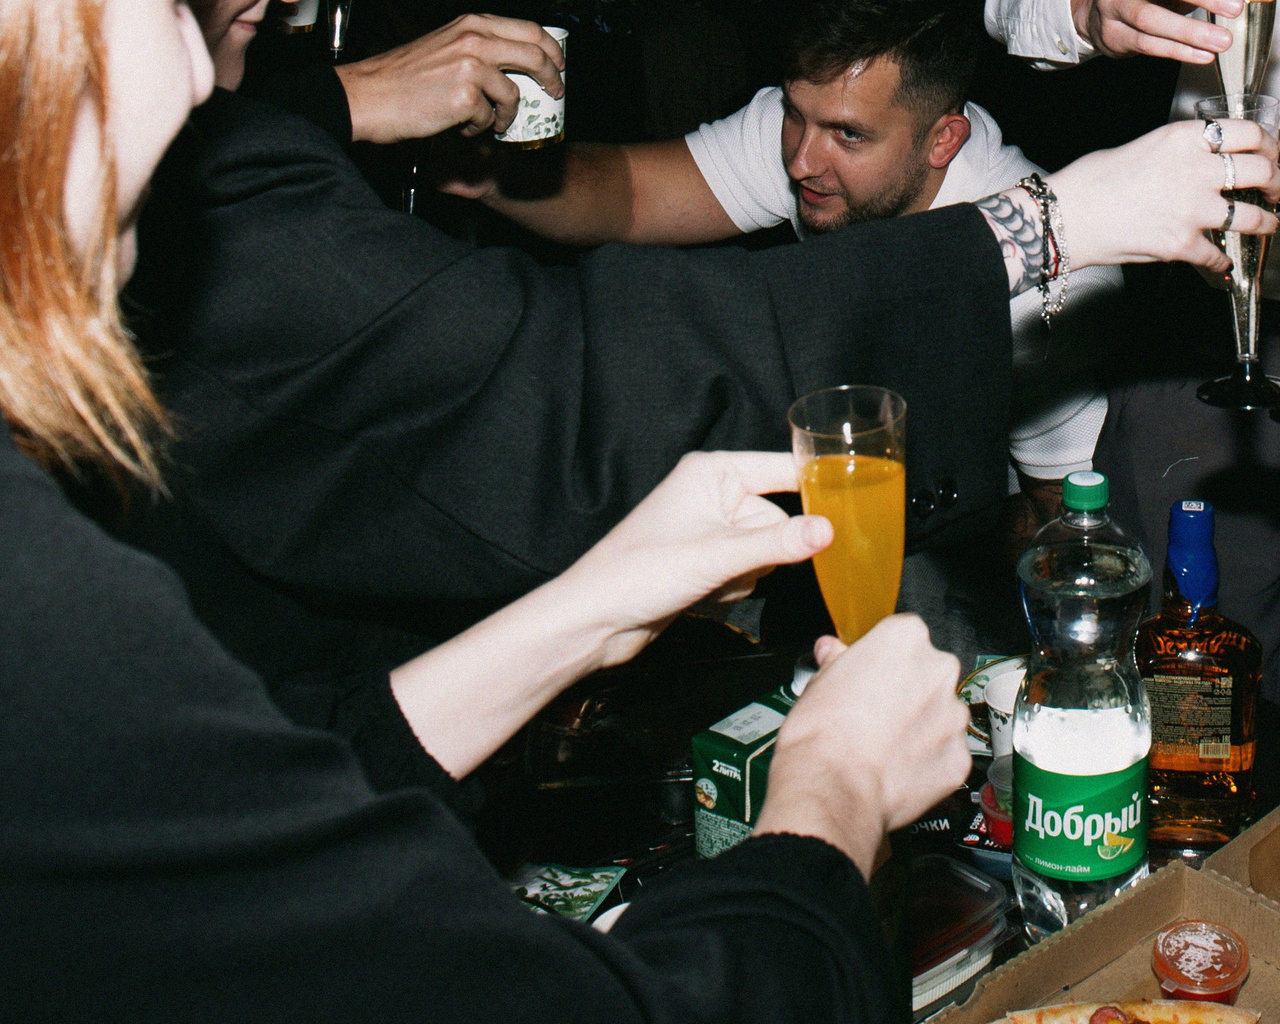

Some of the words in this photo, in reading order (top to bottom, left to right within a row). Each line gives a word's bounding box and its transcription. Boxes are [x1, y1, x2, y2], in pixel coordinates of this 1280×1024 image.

[712, 759, 720, 773] 2
[1025, 791, 1144, 846] Добрый
[1034, 857, 1091, 873] лимон-лайм
